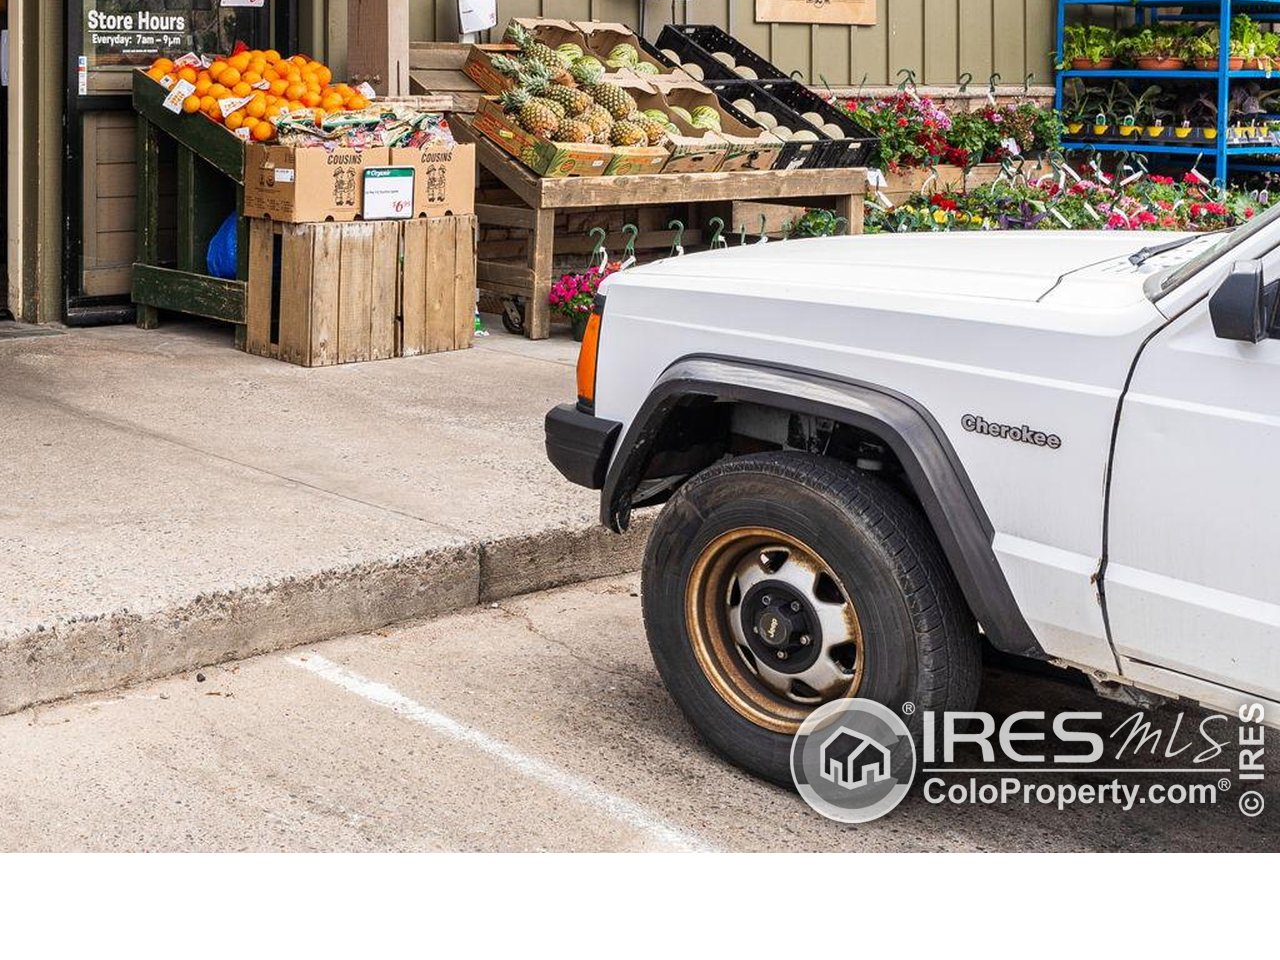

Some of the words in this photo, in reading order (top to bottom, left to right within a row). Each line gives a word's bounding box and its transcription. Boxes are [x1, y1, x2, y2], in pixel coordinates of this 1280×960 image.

[88, 9, 133, 30] Store
[138, 11, 185, 30] Hours
[92, 33, 132, 47] Everyday:
[136, 34, 154, 45] 7am
[327, 154, 362, 165] COUSINS
[421, 151, 452, 164] COUSINS
[961, 413, 1061, 450] Cherokee
